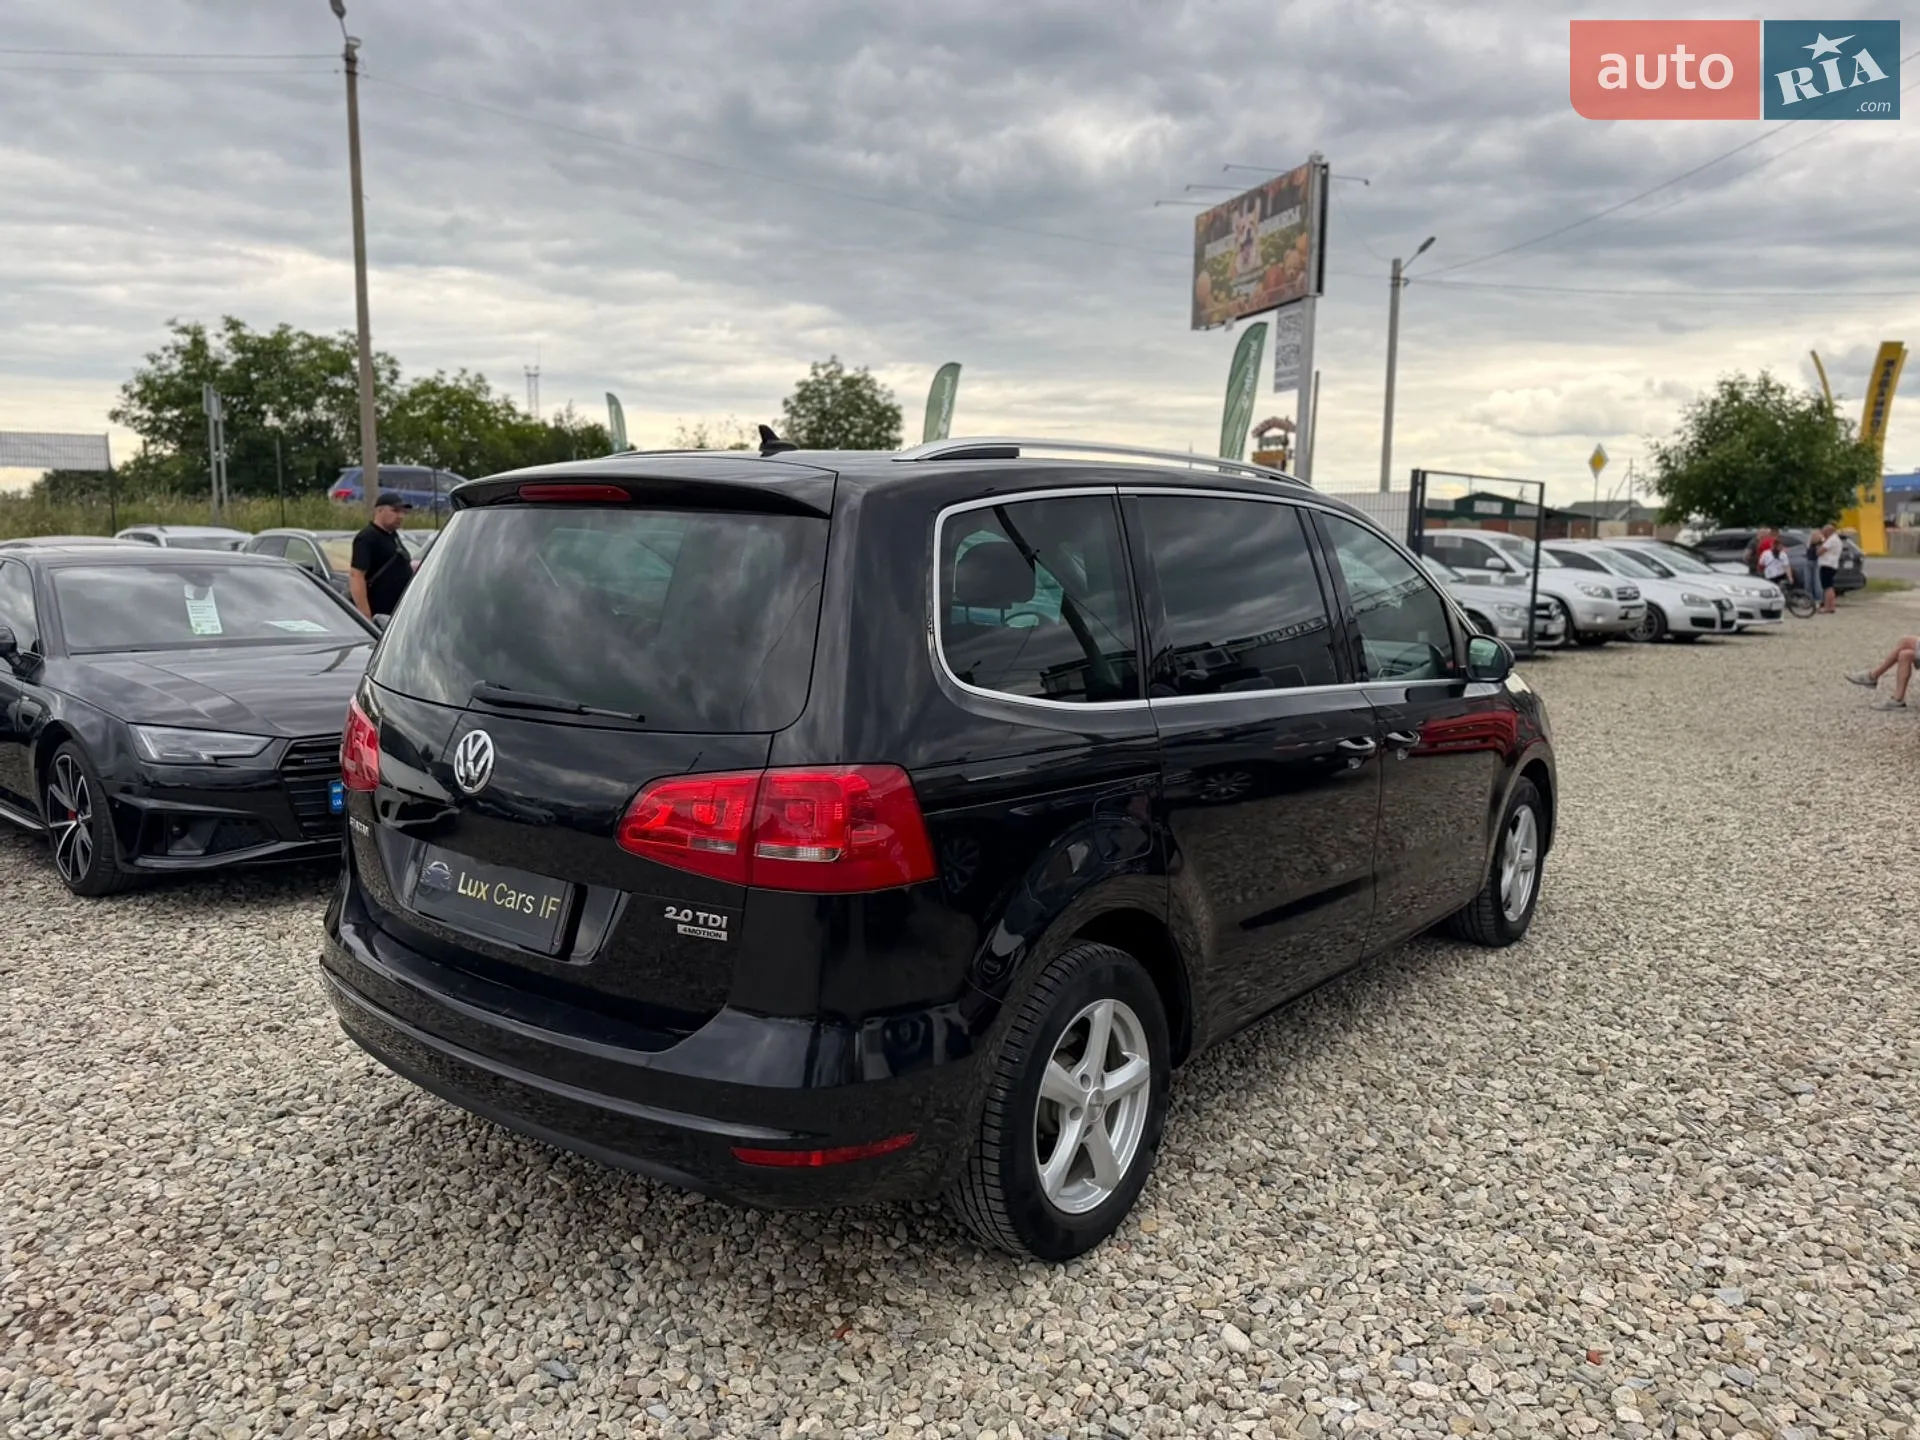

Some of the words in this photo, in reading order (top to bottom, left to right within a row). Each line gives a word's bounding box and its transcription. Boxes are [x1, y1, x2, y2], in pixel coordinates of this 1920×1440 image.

[457, 871, 490, 901] Lux
[493, 882, 536, 914] Cars
[538, 895, 561, 919] IF
[696, 911, 728, 929] TDI
[681, 926, 723, 939] 4MOTION
